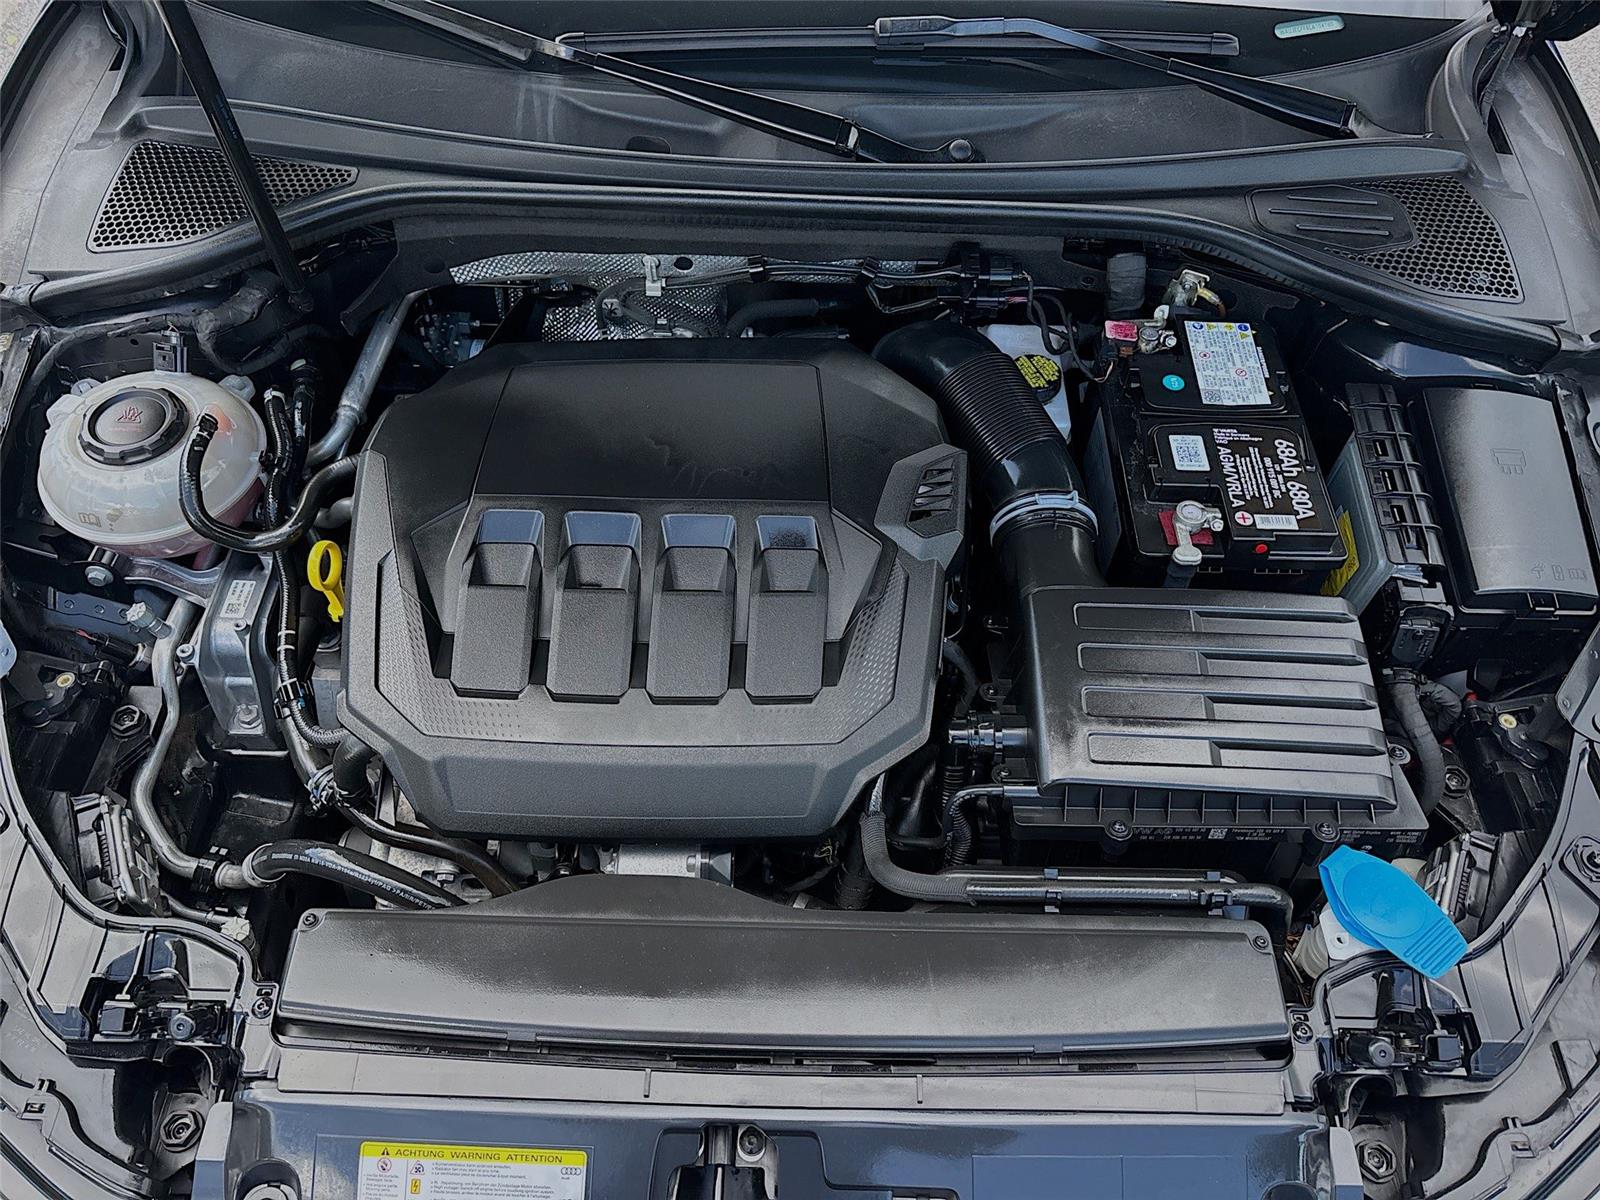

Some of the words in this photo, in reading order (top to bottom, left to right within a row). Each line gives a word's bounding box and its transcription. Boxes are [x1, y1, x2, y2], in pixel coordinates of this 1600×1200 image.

[1216, 446, 1246, 508] AGM/VRLA
[1274, 438, 1302, 477] 68Ah
[1286, 481, 1316, 520] 680A
[395, 1149, 444, 1158] ACHTUNG
[450, 1151, 501, 1161] WARNING
[506, 1153, 563, 1163] ATTENTION
